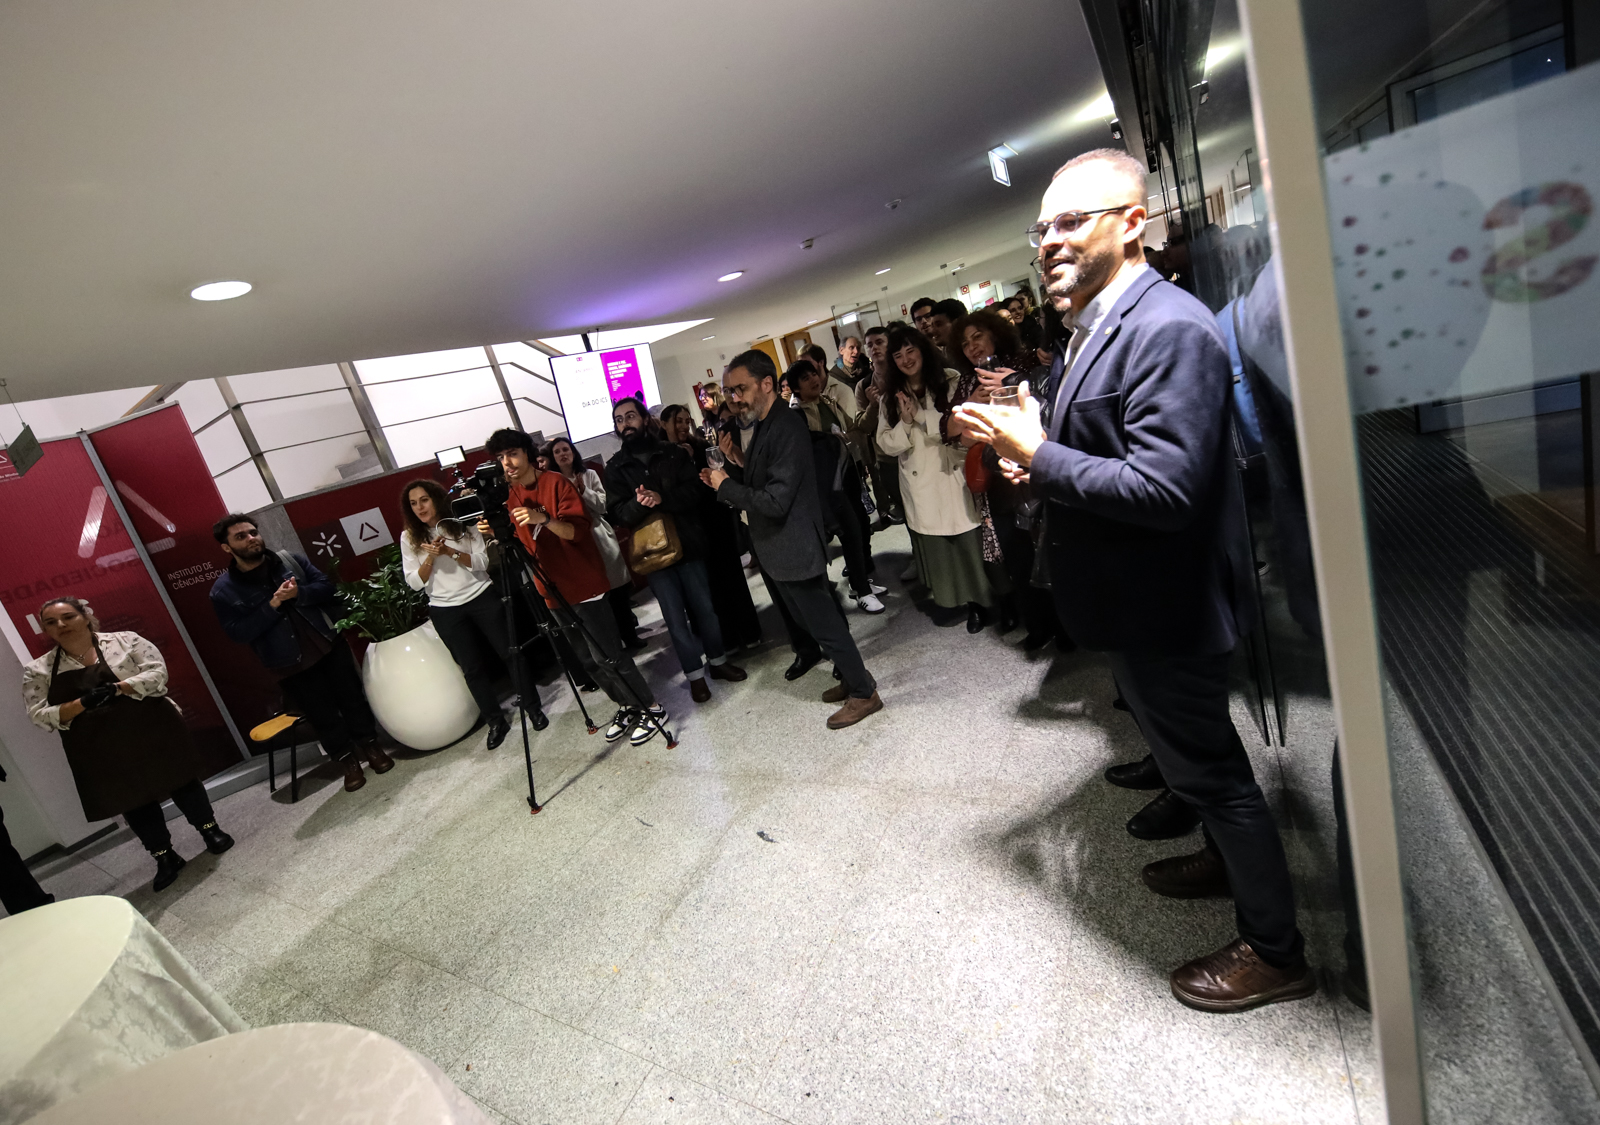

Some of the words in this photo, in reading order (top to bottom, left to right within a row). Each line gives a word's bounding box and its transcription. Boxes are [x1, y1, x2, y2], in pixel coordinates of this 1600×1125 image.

[167, 564, 202, 580] INSTITUTO
[202, 561, 213, 571] DE
[172, 574, 204, 590] CIÊNCIAS
